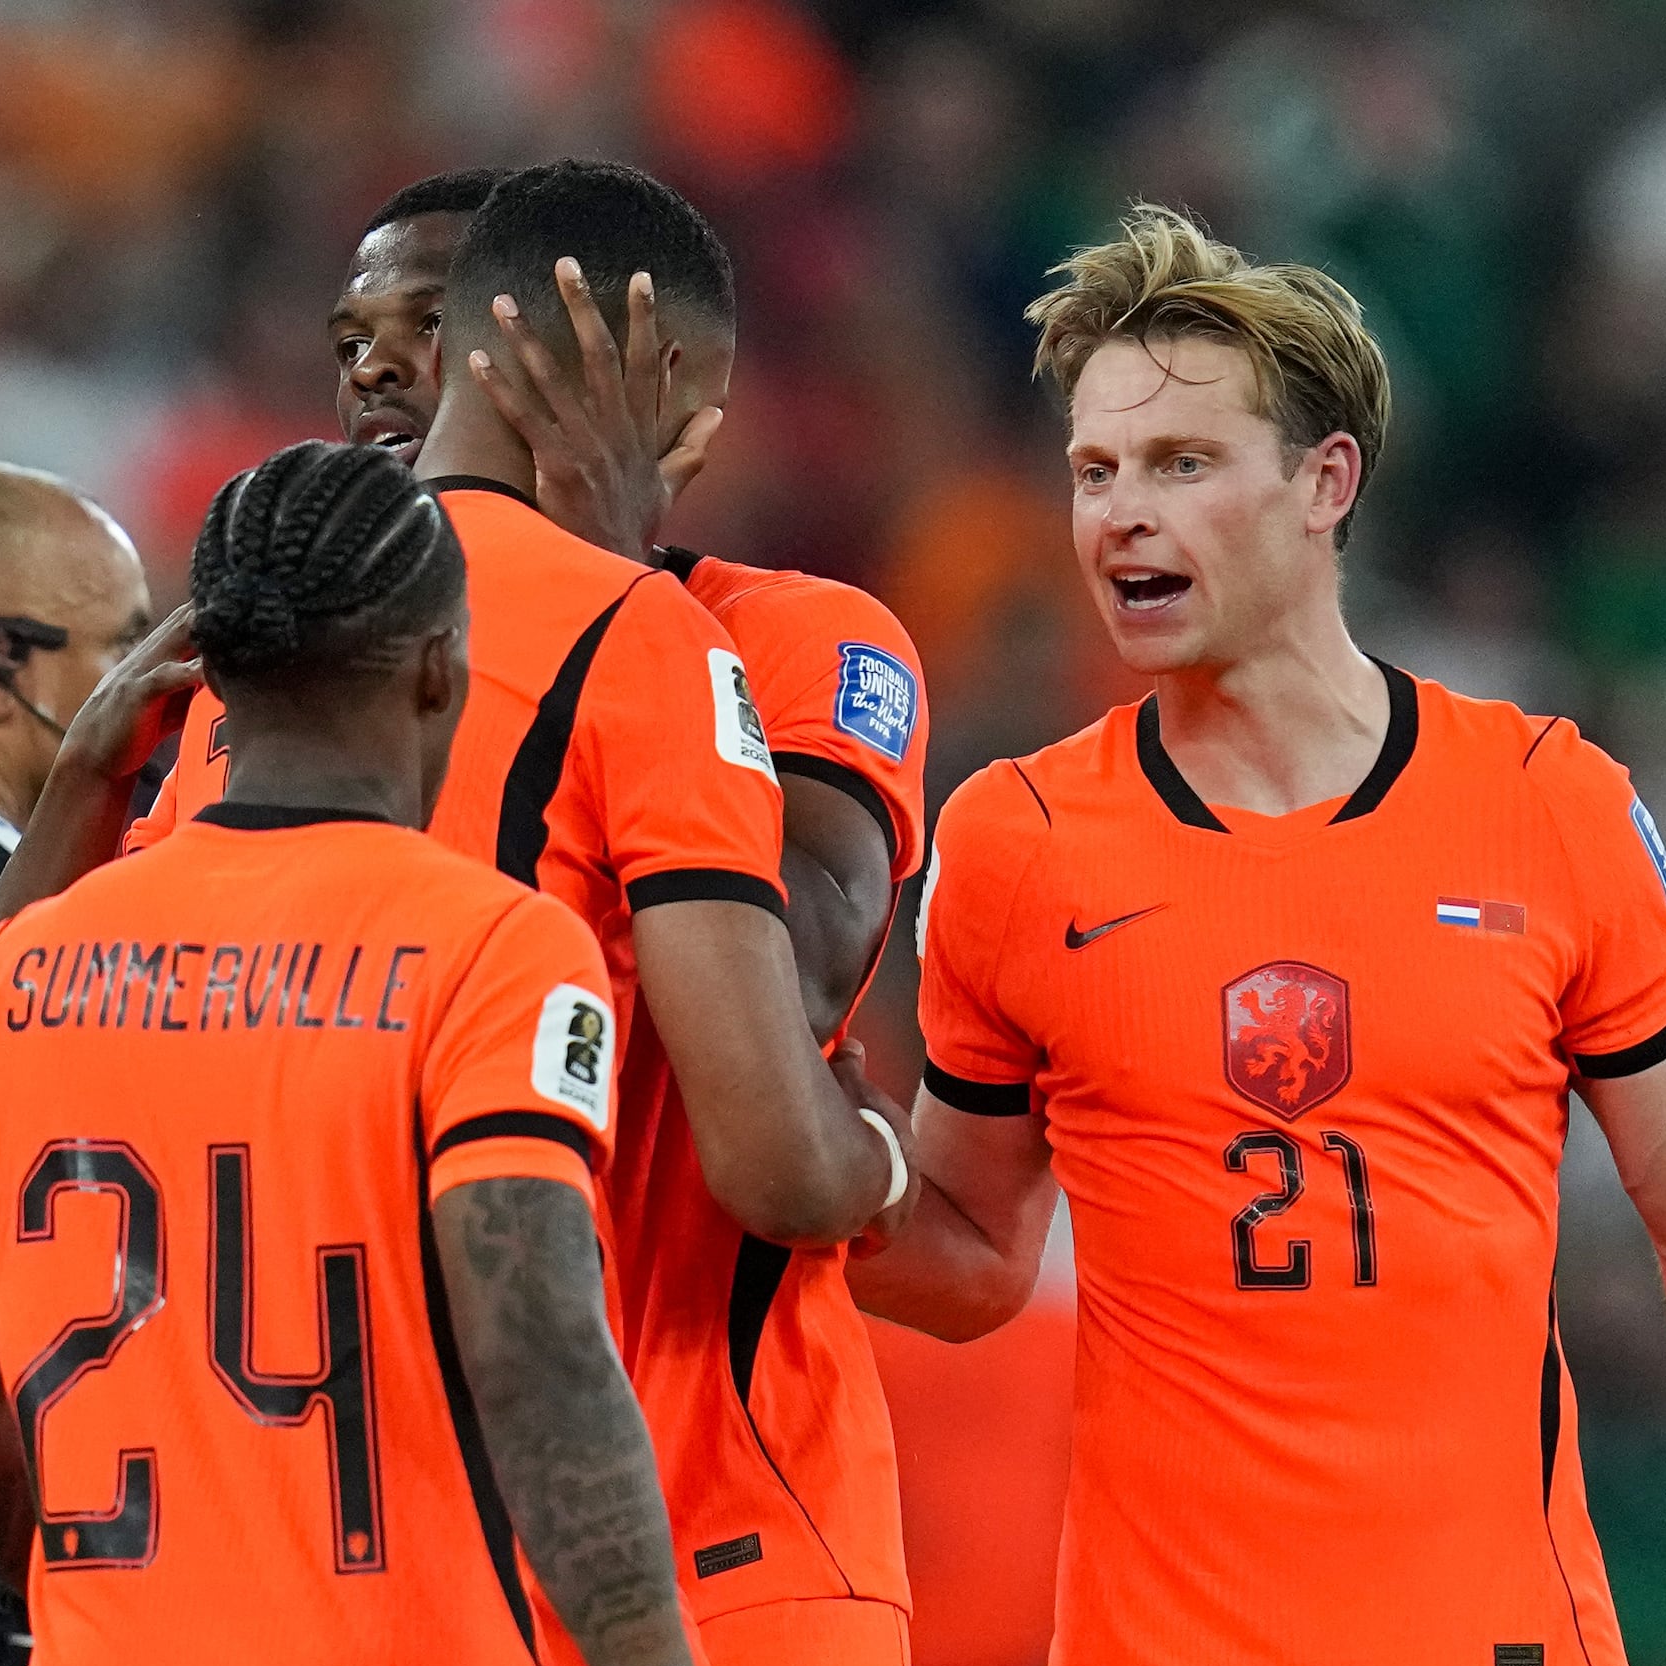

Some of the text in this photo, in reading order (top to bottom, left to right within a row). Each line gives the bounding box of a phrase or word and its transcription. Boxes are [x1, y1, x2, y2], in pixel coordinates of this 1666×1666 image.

[859, 654, 910, 697] FOOTBALL
[859, 671, 910, 717] UNITES
[851, 691, 877, 711] the
[869, 717, 890, 739] FIFA
[7, 941, 426, 1033] SUMMERVILLE
[1223, 1130, 1377, 1290] 21
[12, 1138, 386, 1575] 24
